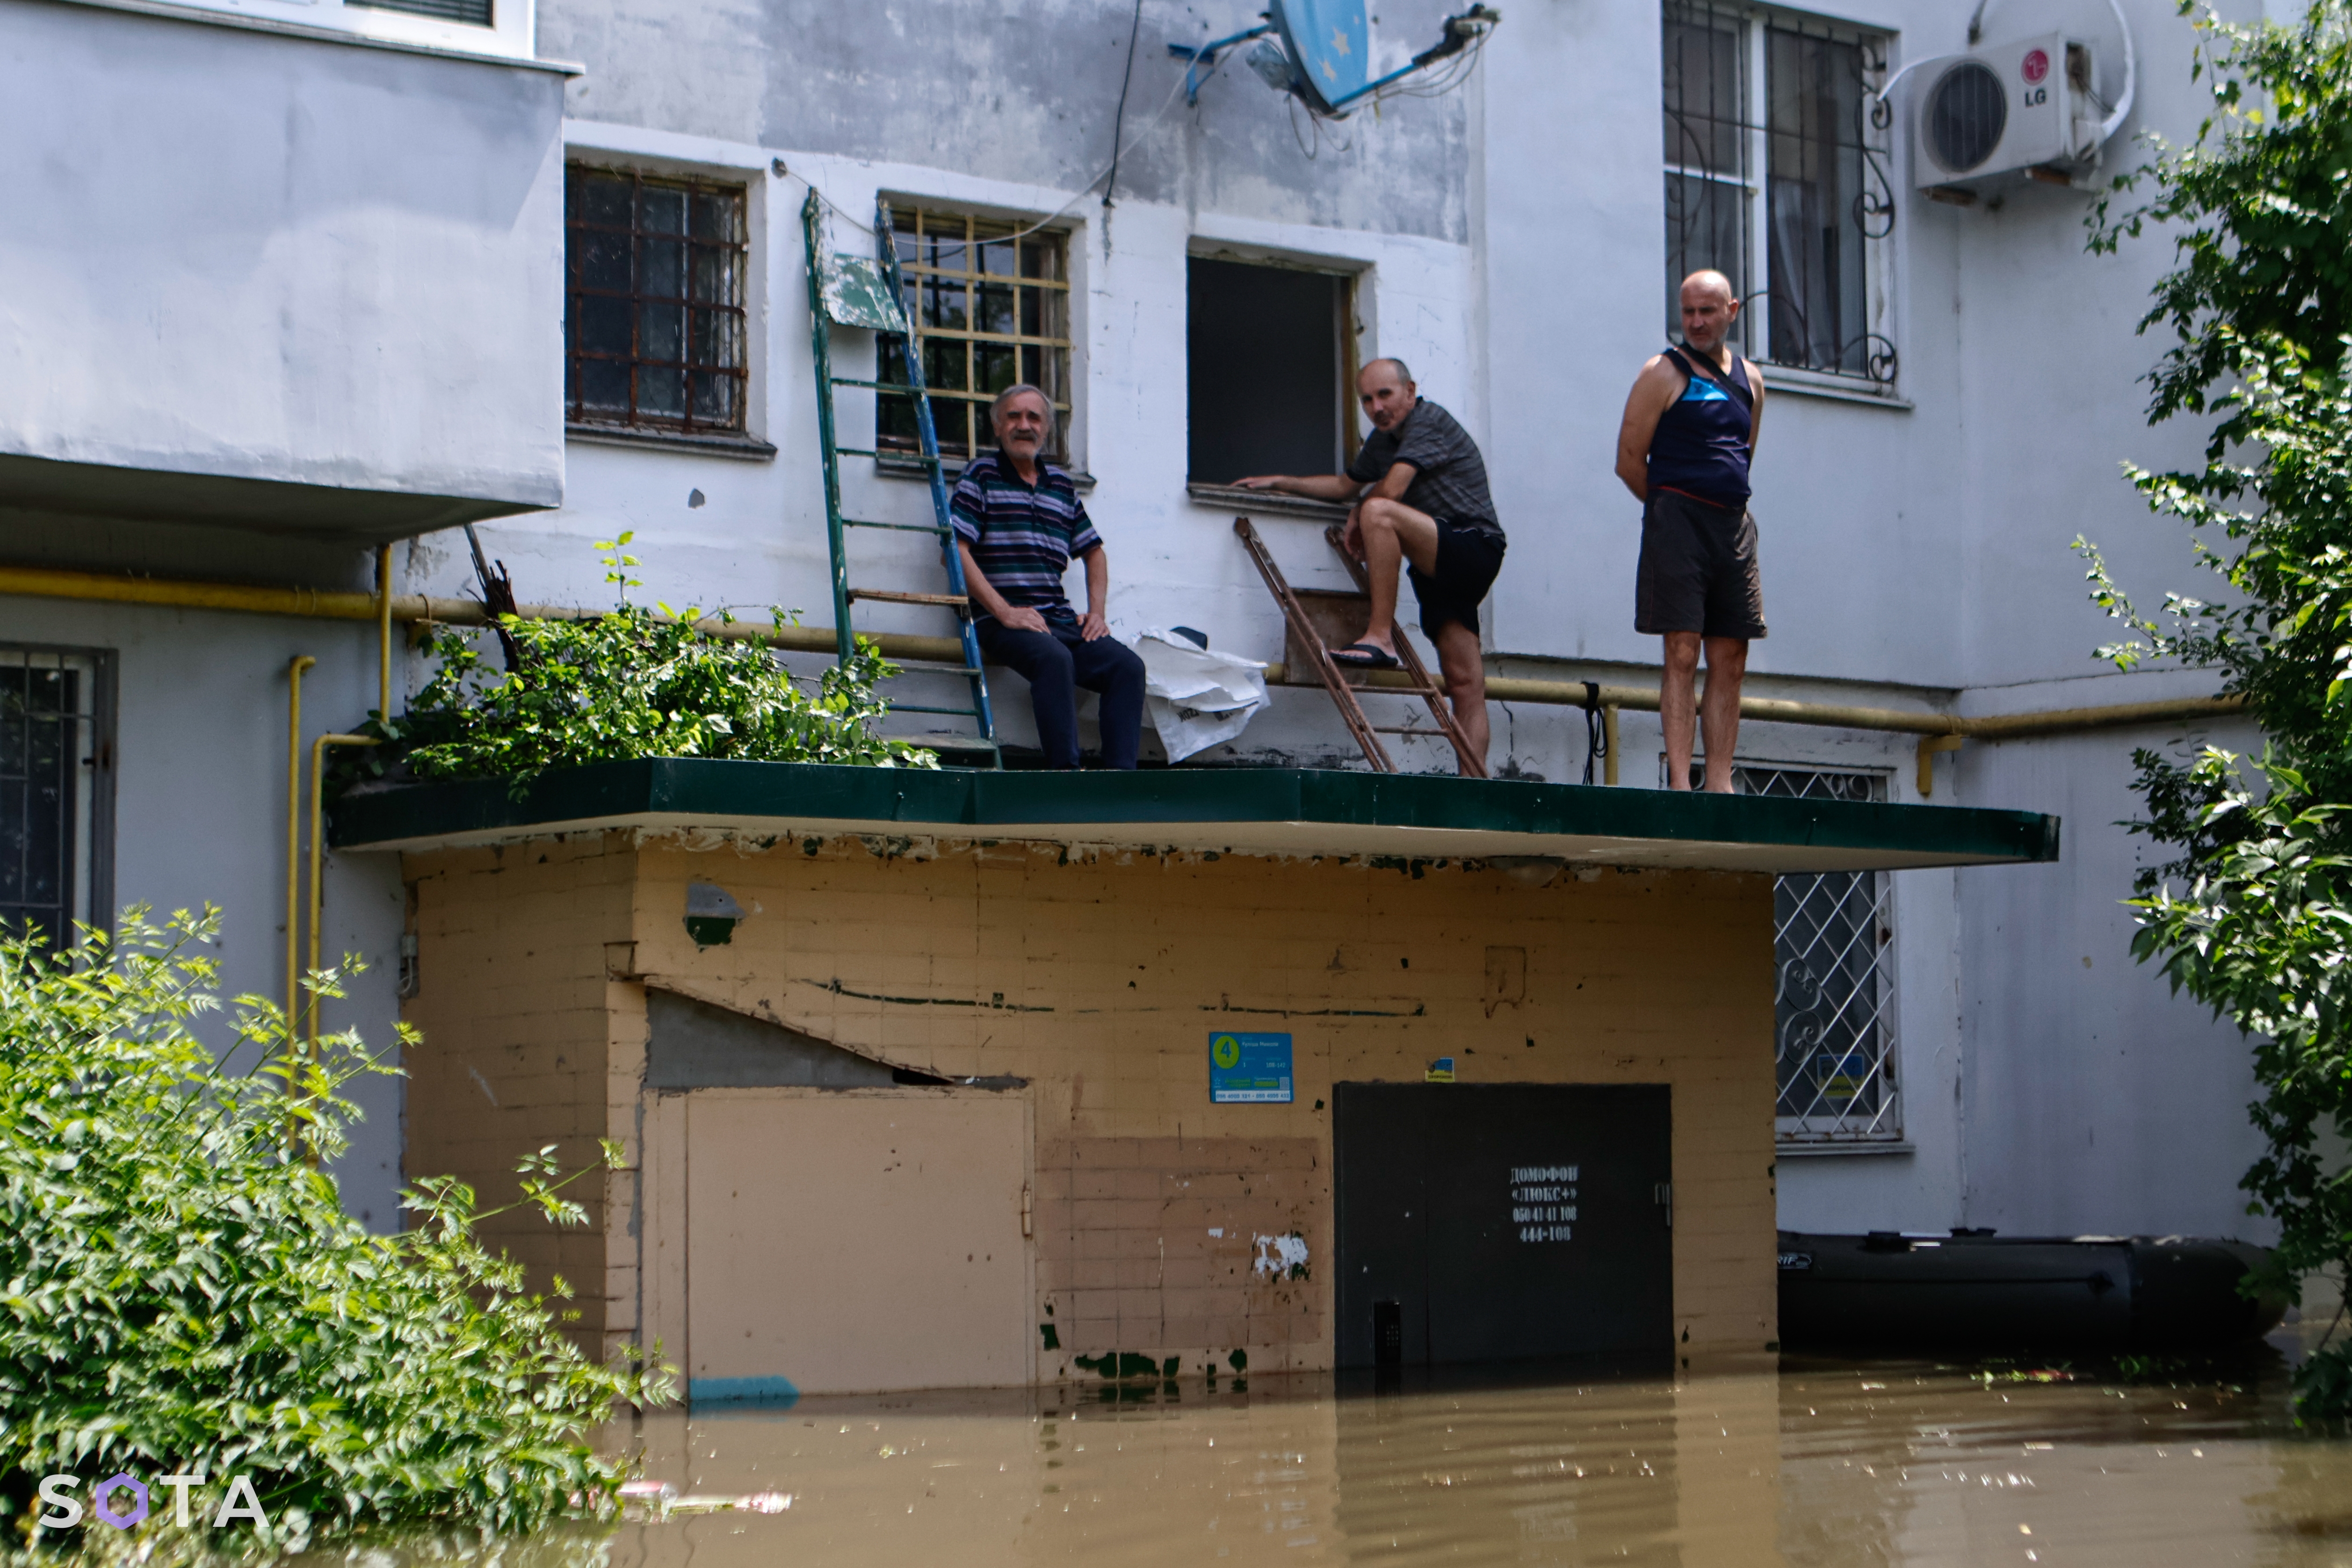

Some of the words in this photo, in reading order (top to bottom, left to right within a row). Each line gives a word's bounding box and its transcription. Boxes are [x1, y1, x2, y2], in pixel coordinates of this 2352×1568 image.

[2025, 87, 2046, 107] LG
[1220, 1041, 1231, 1058] 4
[1510, 1166, 1578, 1185] ДОМОФОН
[1512, 1186, 1578, 1202] «ЛЮКС+»
[1532, 1207, 1543, 1222] 41
[1546, 1206, 1556, 1221] 41
[1560, 1206, 1577, 1221] 108
[1520, 1226, 1571, 1242] 444-108
